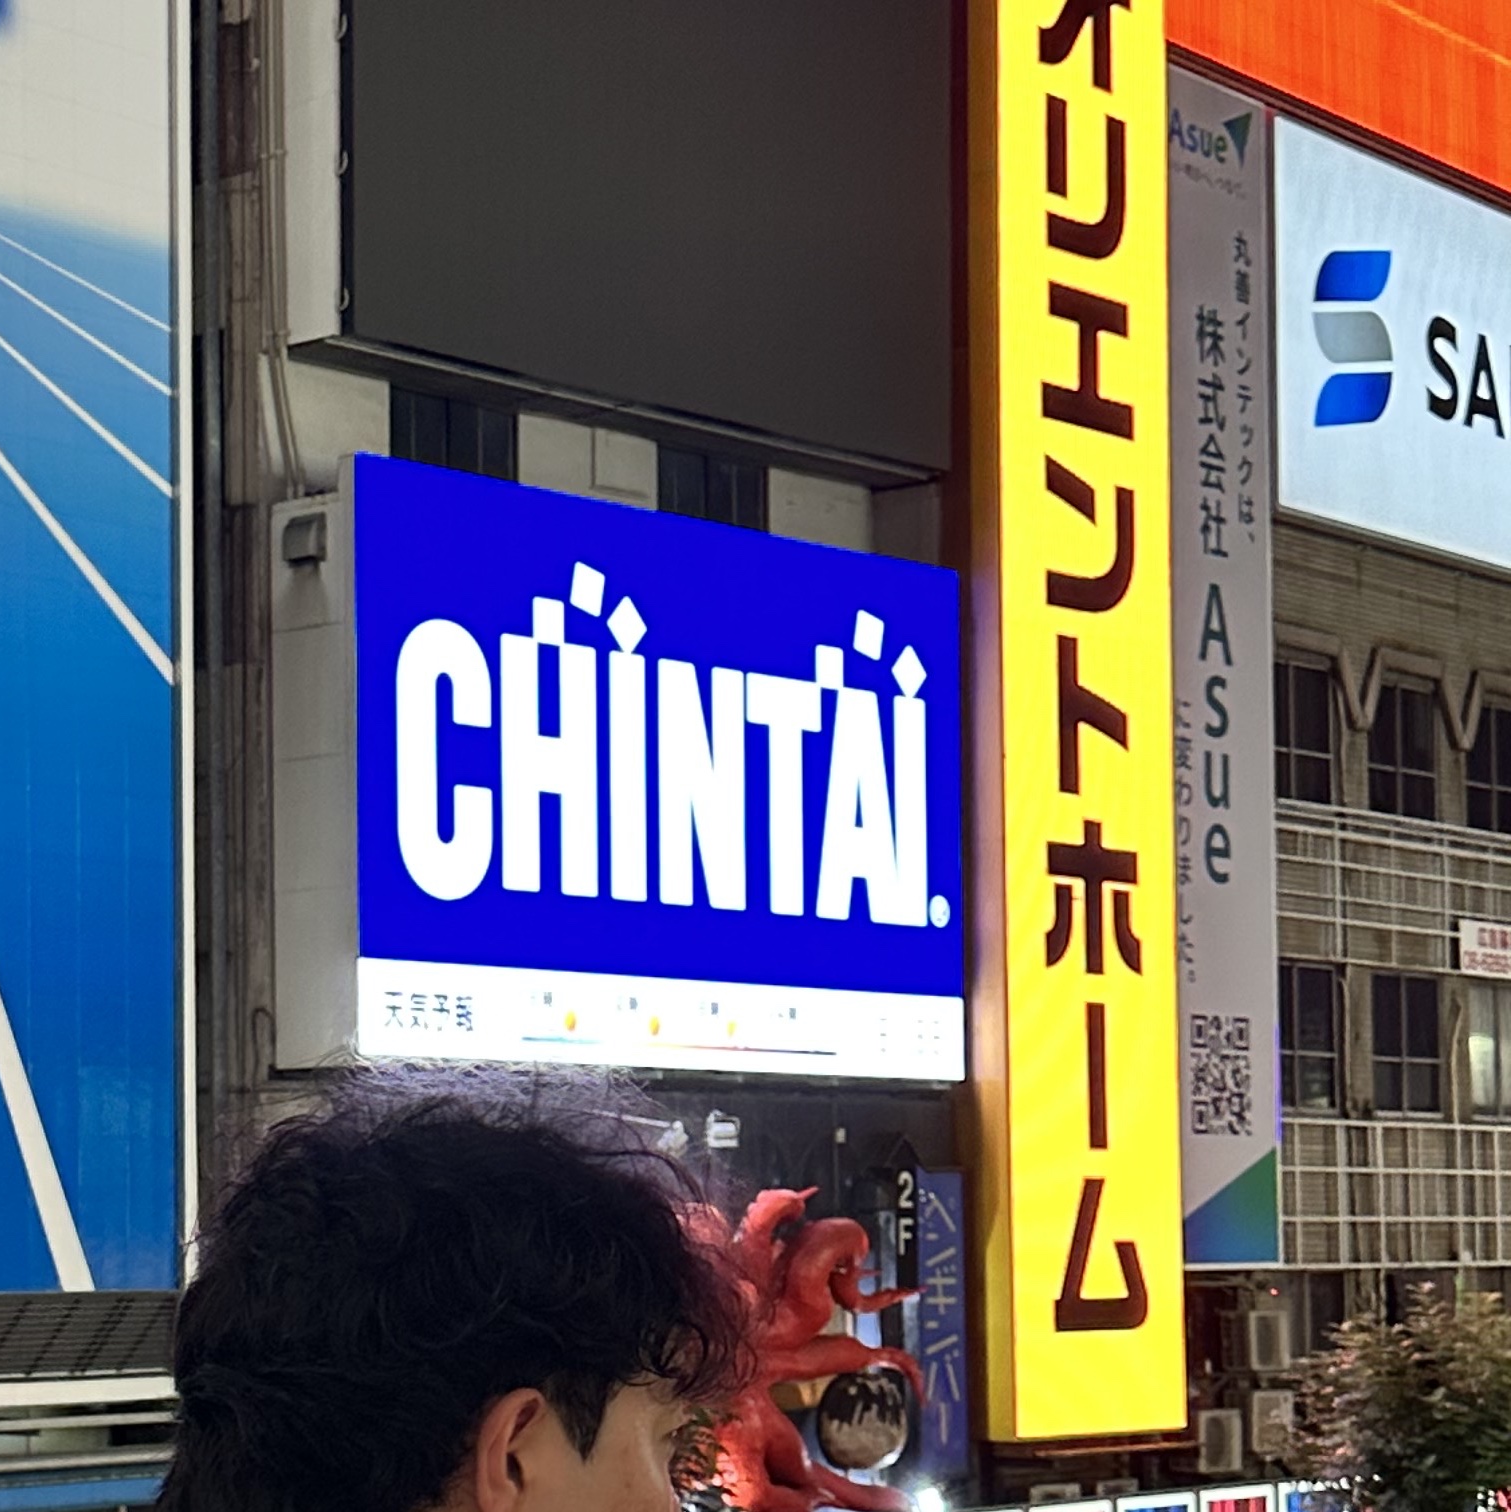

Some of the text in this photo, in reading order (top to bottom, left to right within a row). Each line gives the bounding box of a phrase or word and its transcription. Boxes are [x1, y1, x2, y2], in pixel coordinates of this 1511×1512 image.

[1169, 108, 1228, 164] Asue
[1195, 304, 1229, 558] 株式会社
[1425, 315, 1511, 440] SA
[395, 562, 929, 928] CHINTAI
